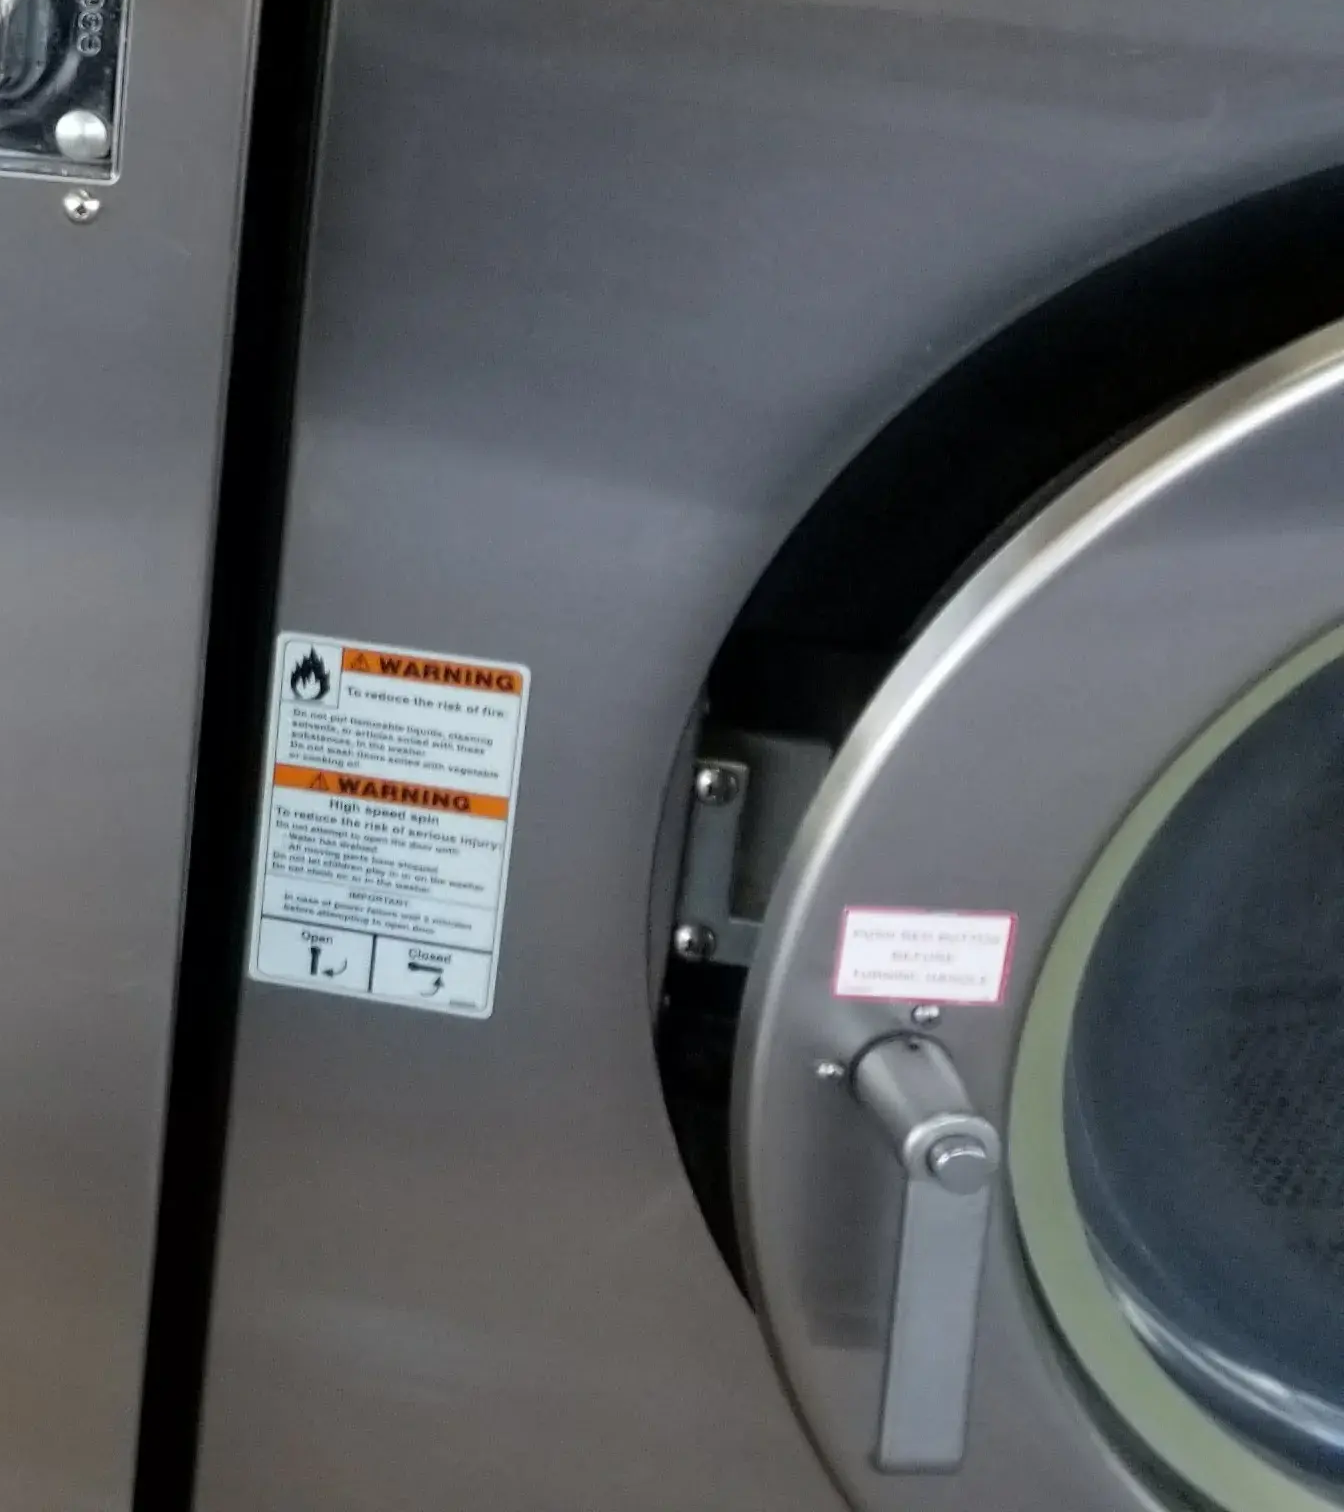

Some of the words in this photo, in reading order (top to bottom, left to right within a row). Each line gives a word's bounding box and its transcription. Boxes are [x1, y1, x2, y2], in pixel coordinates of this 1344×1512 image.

[378, 657, 515, 691] WARNING
[347, 687, 361, 697] To
[364, 690, 409, 704] reduce
[413, 697, 435, 708] the
[438, 700, 462, 712] risk
[465, 704, 479, 714] of
[337, 777, 470, 810] WARNING
[329, 798, 360, 815] High
[365, 804, 406, 821] speed
[410, 811, 440, 826] spin
[300, 931, 333, 945] Open
[408, 948, 451, 964] Closed
